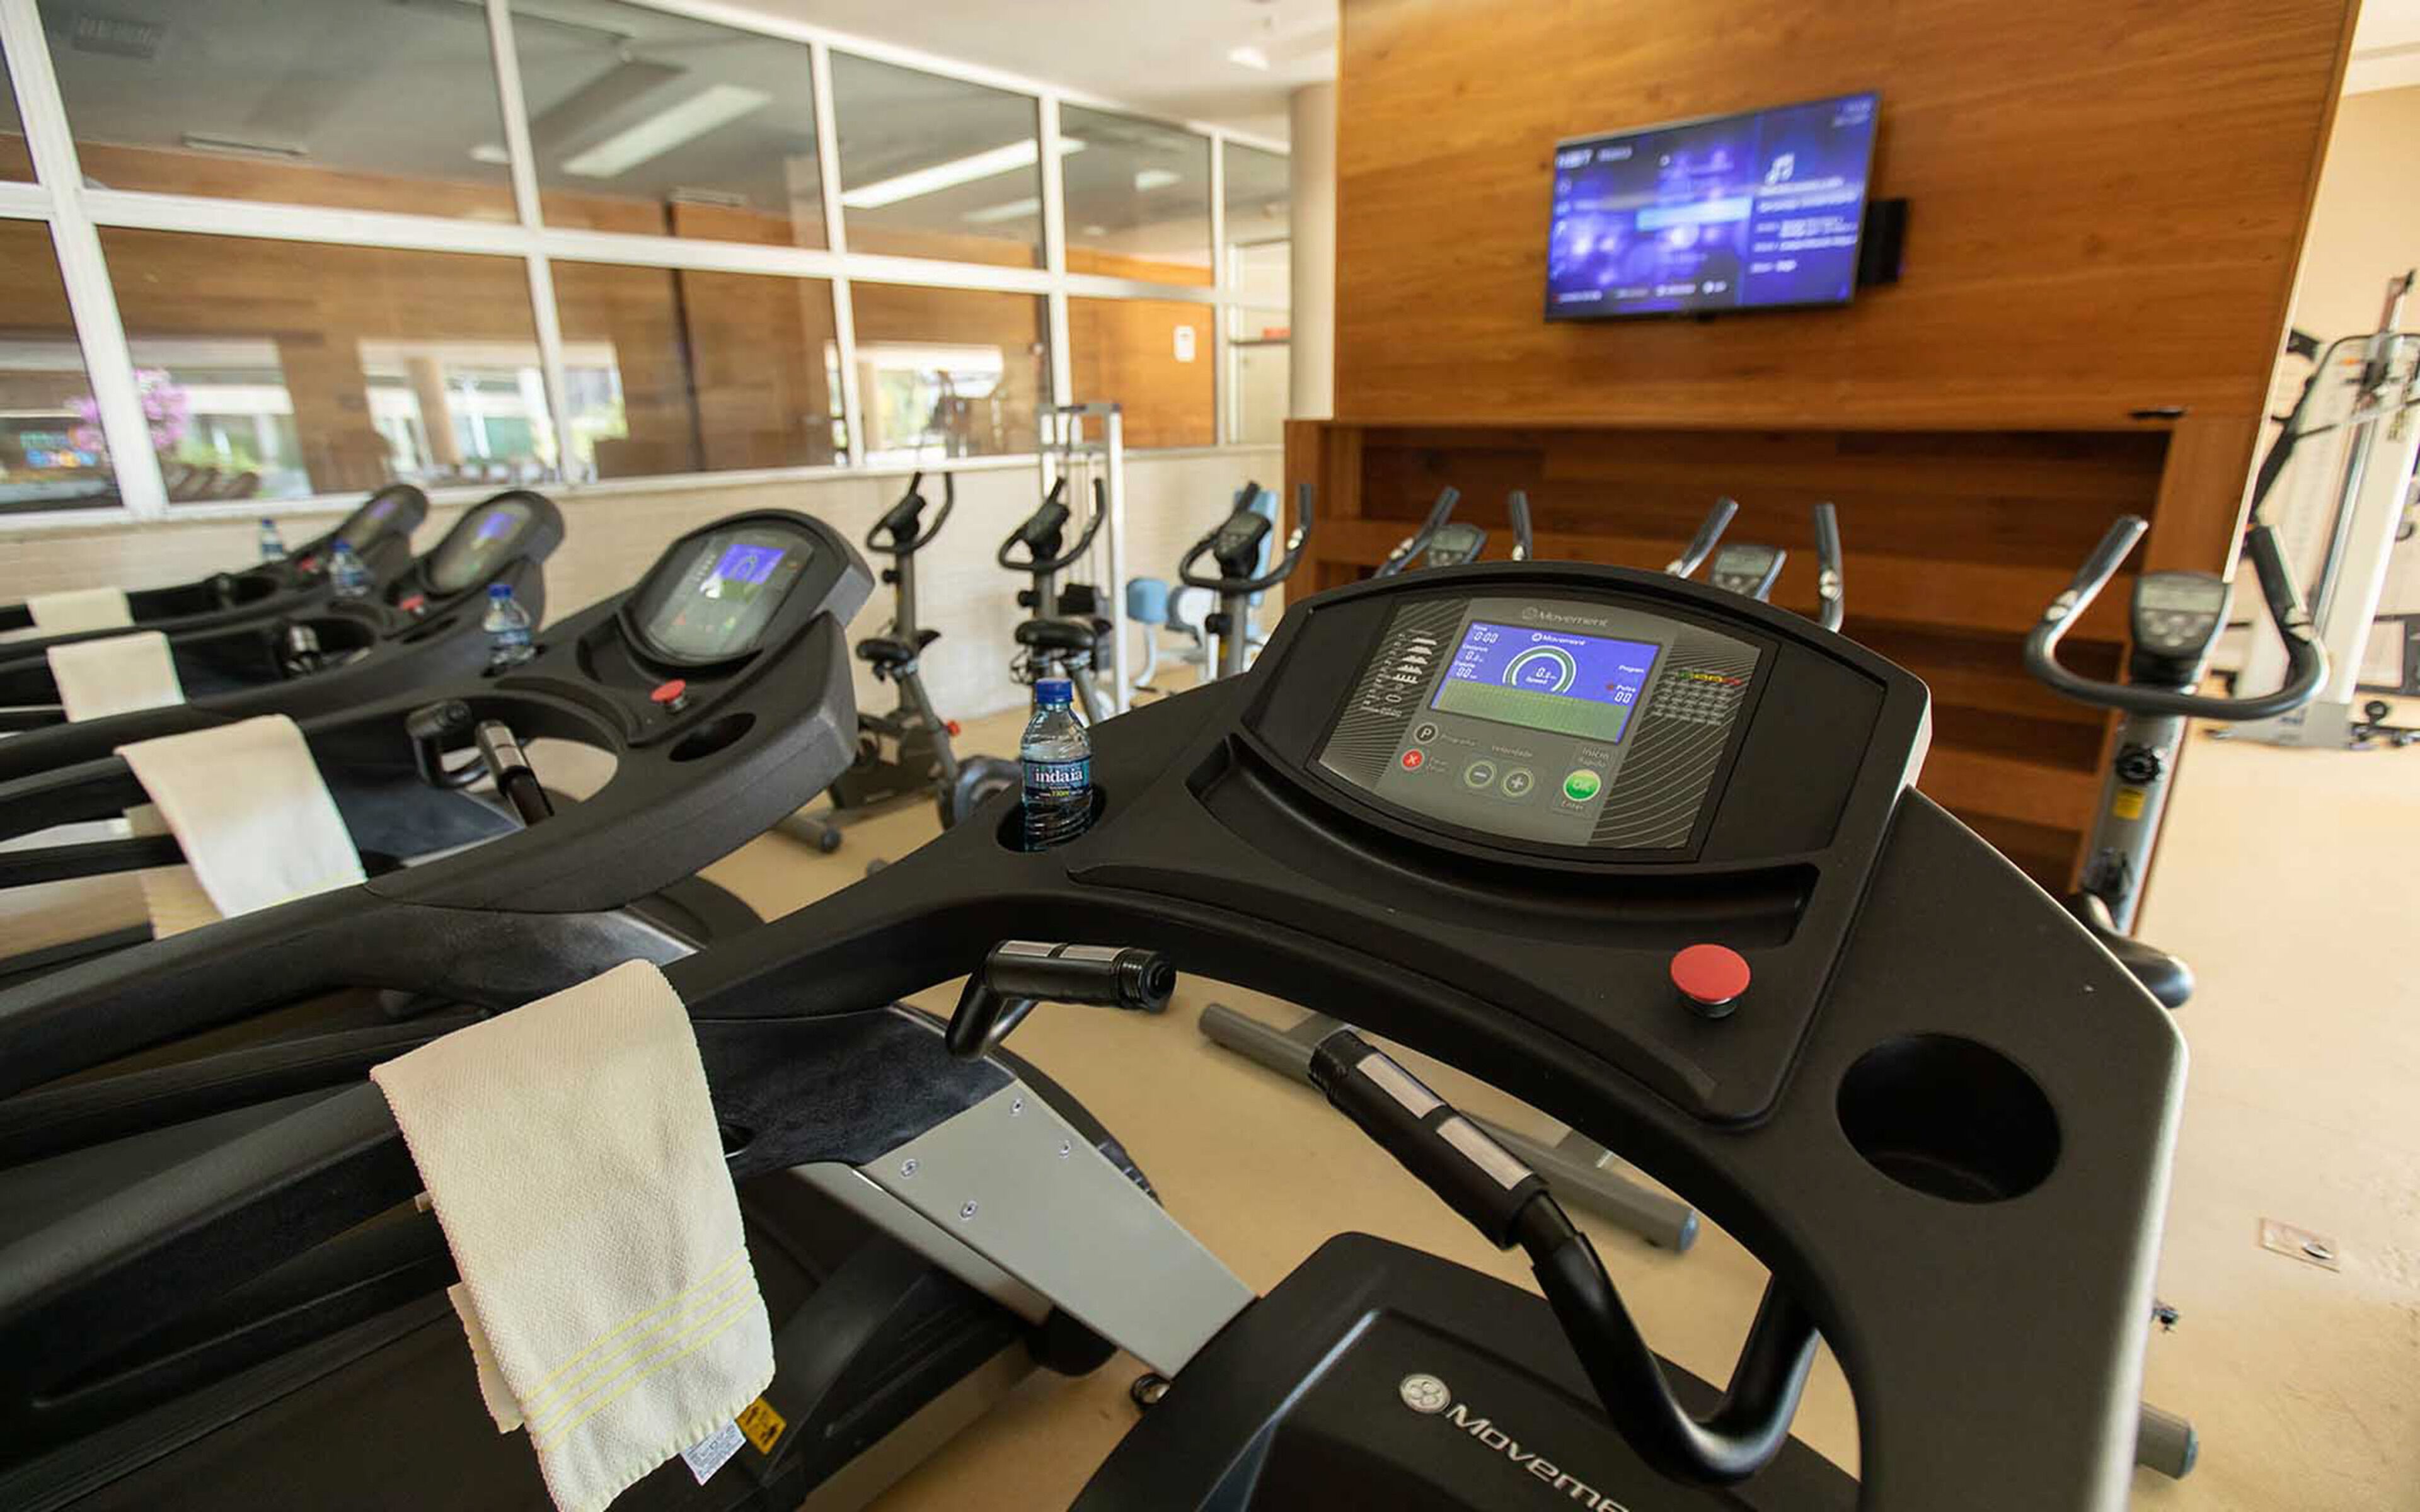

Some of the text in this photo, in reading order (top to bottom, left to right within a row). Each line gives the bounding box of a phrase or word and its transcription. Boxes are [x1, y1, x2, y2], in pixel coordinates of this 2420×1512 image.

[1540, 610, 1608, 626] Movement
[1616, 684, 1636, 693] Pulse
[1614, 692, 1632, 704] 00
[1420, 728, 1432, 738] P
